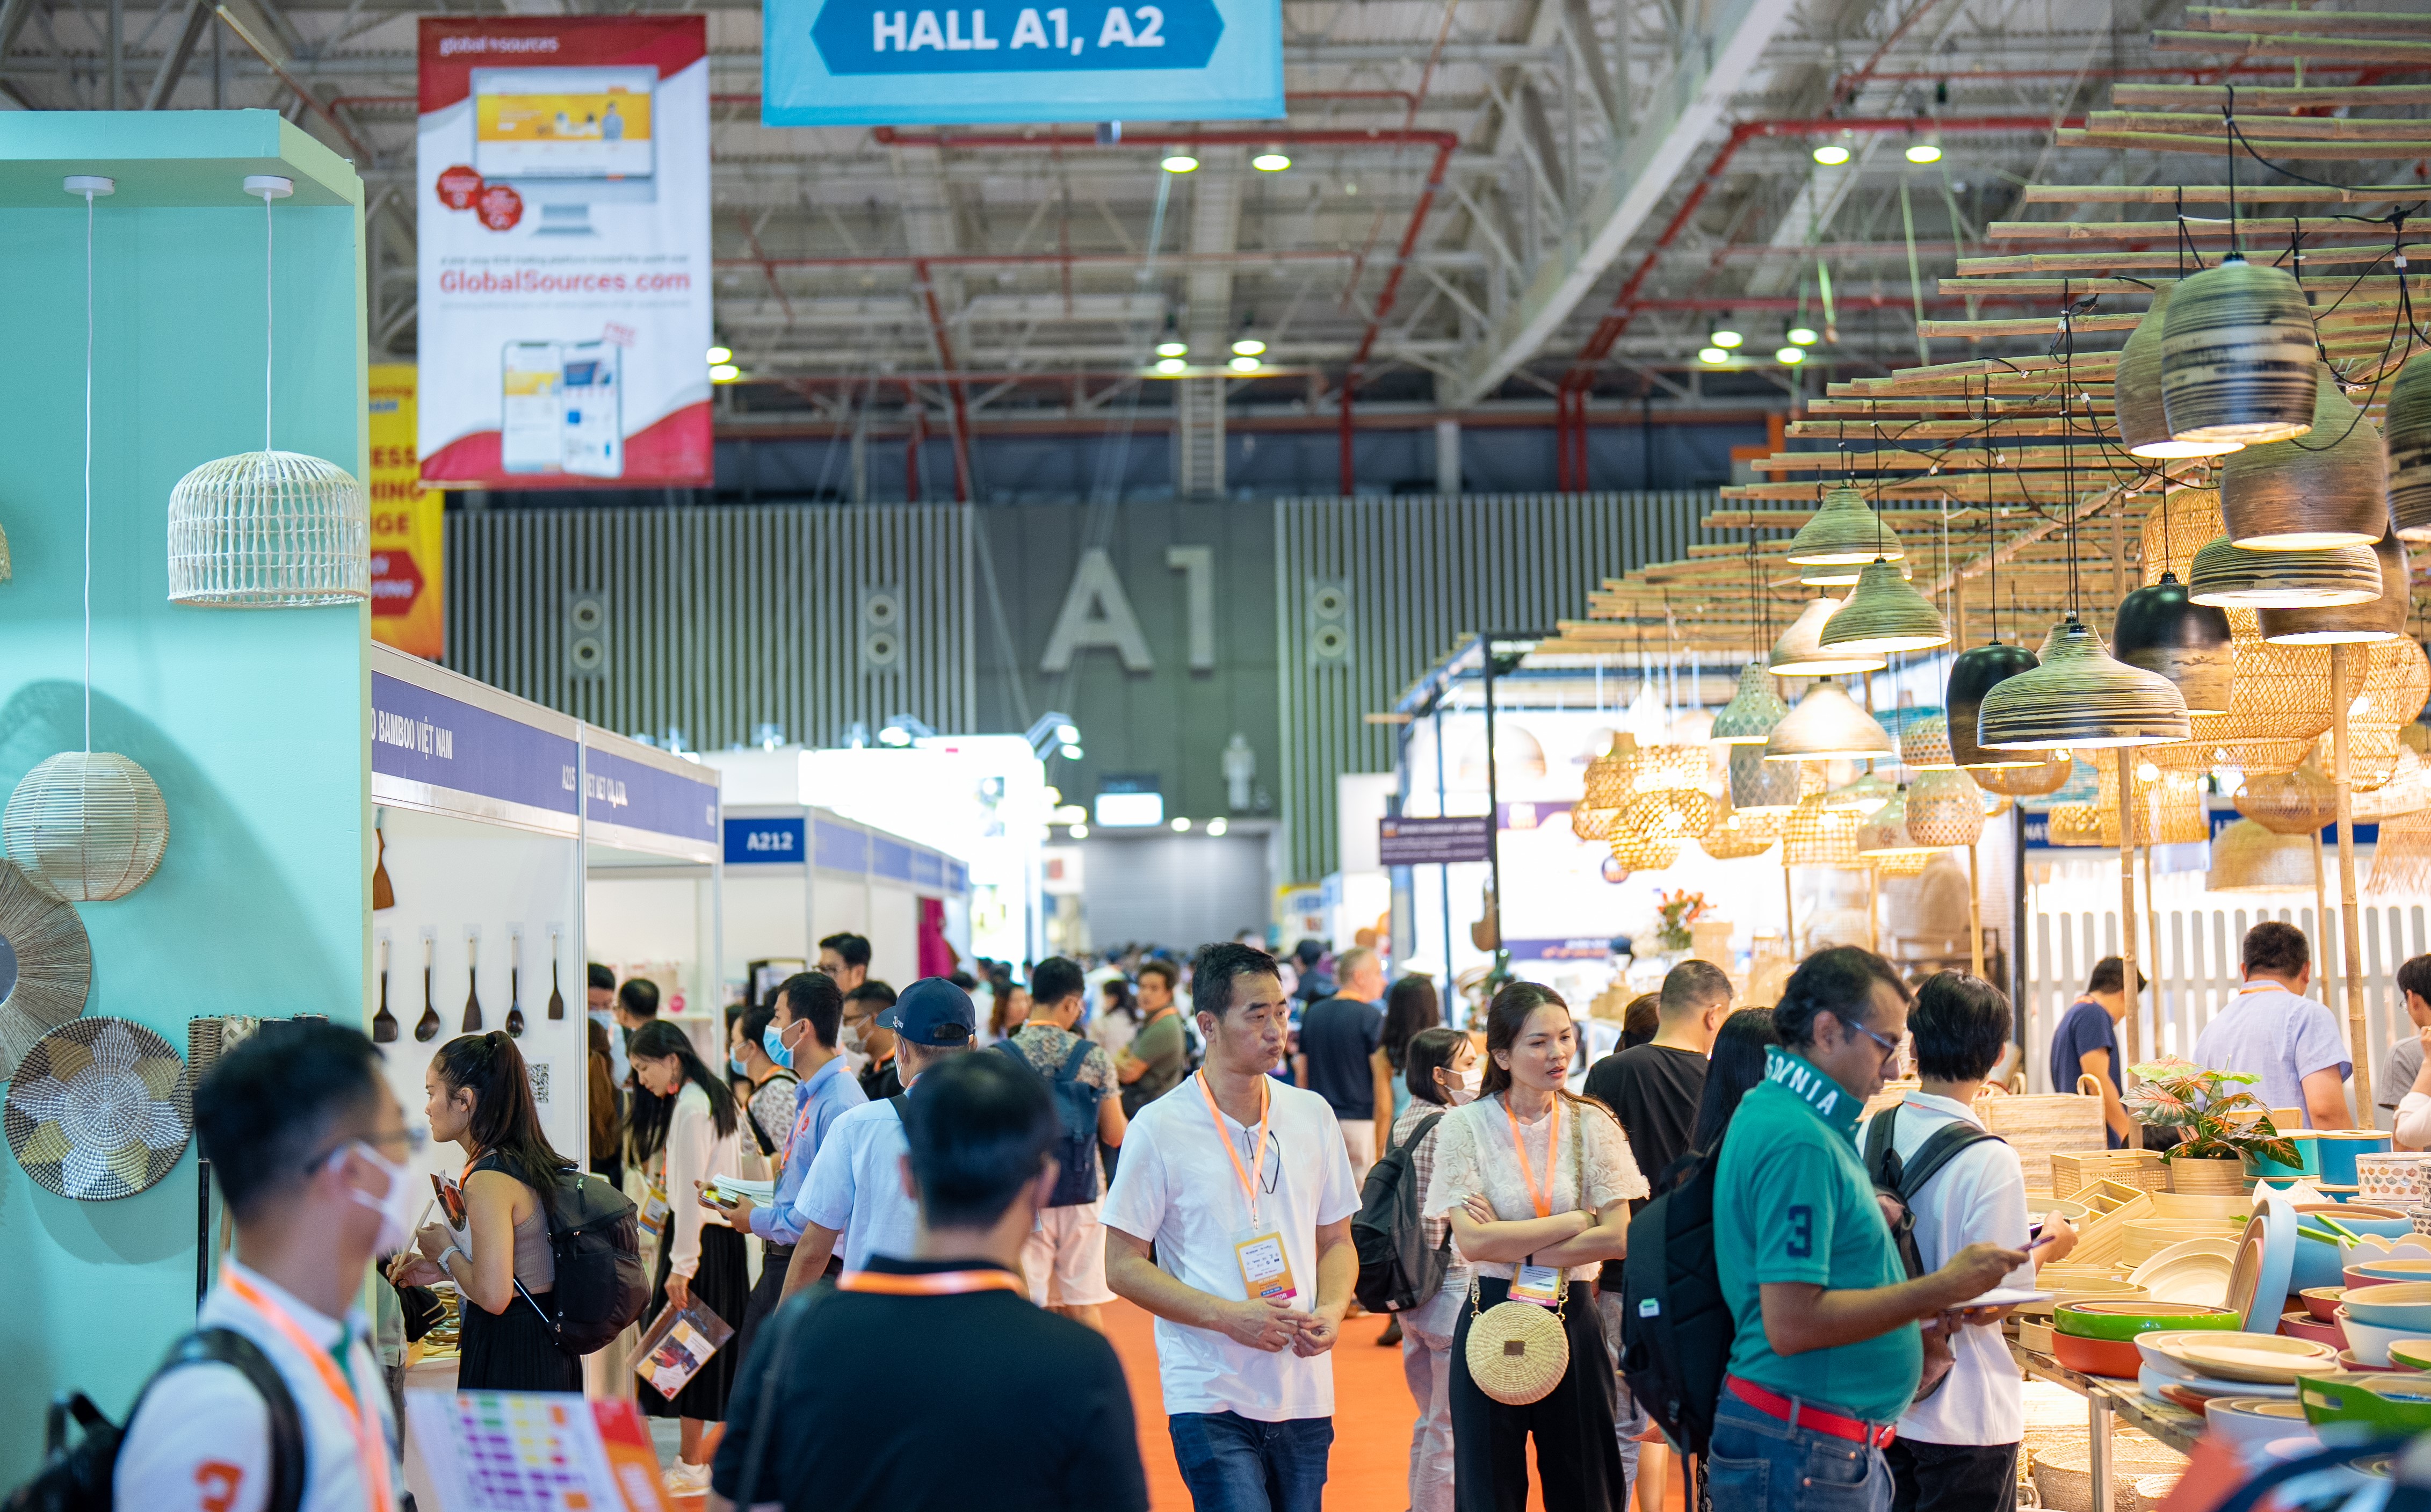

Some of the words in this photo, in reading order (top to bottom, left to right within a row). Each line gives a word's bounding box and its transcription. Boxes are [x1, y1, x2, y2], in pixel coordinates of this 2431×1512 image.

[872, 9, 1000, 52] HALL
[1010, 9, 1084, 56] A1,
[1097, 5, 1164, 48] A2
[439, 269, 691, 293] GlobalSources.com
[371, 512, 410, 536] GE
[1040, 545, 1215, 672] A1
[379, 710, 415, 750] BAMBOO
[416, 715, 434, 760] VIỆT
[436, 727, 452, 759] NAM
[562, 764, 575, 792] A215
[747, 831, 794, 851] A212
[1786, 1205, 1812, 1258] 3
